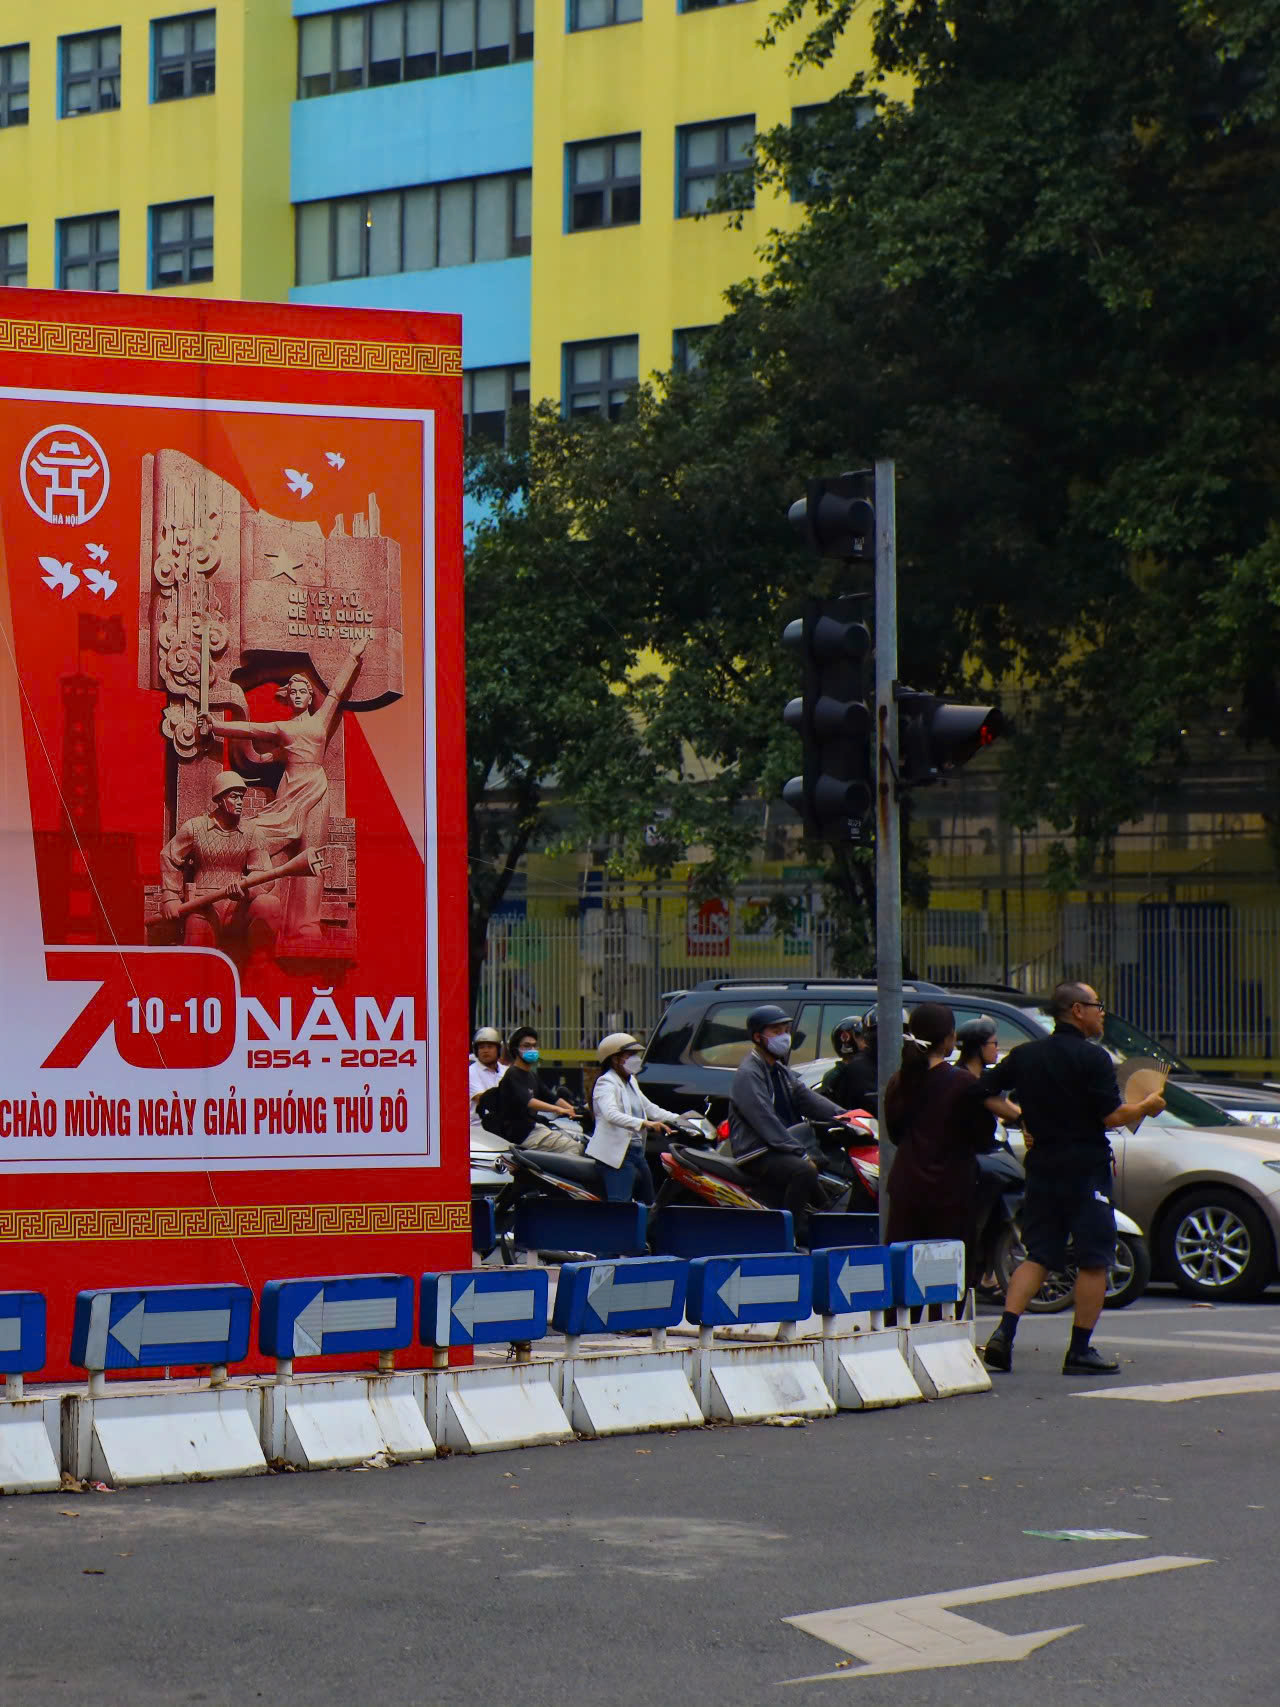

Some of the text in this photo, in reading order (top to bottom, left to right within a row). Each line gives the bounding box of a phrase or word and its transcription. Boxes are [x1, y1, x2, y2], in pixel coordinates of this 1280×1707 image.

[52, 513, 78, 527] HÀ NỘI
[339, 626, 376, 640] SINH
[40, 950, 237, 1069] 70
[242, 987, 415, 1041] NĂM
[247, 1049, 312, 1068] 1954
[340, 1049, 417, 1068] 2024
[64, 1090, 131, 1137] MỪNG
[138, 1090, 197, 1137] NGÀY
[203, 1085, 247, 1136] GIẢI
[253, 1089, 327, 1135] PHÓNG
[333, 1083, 374, 1134] THỦ
[379, 1088, 408, 1133] ĐÔ
